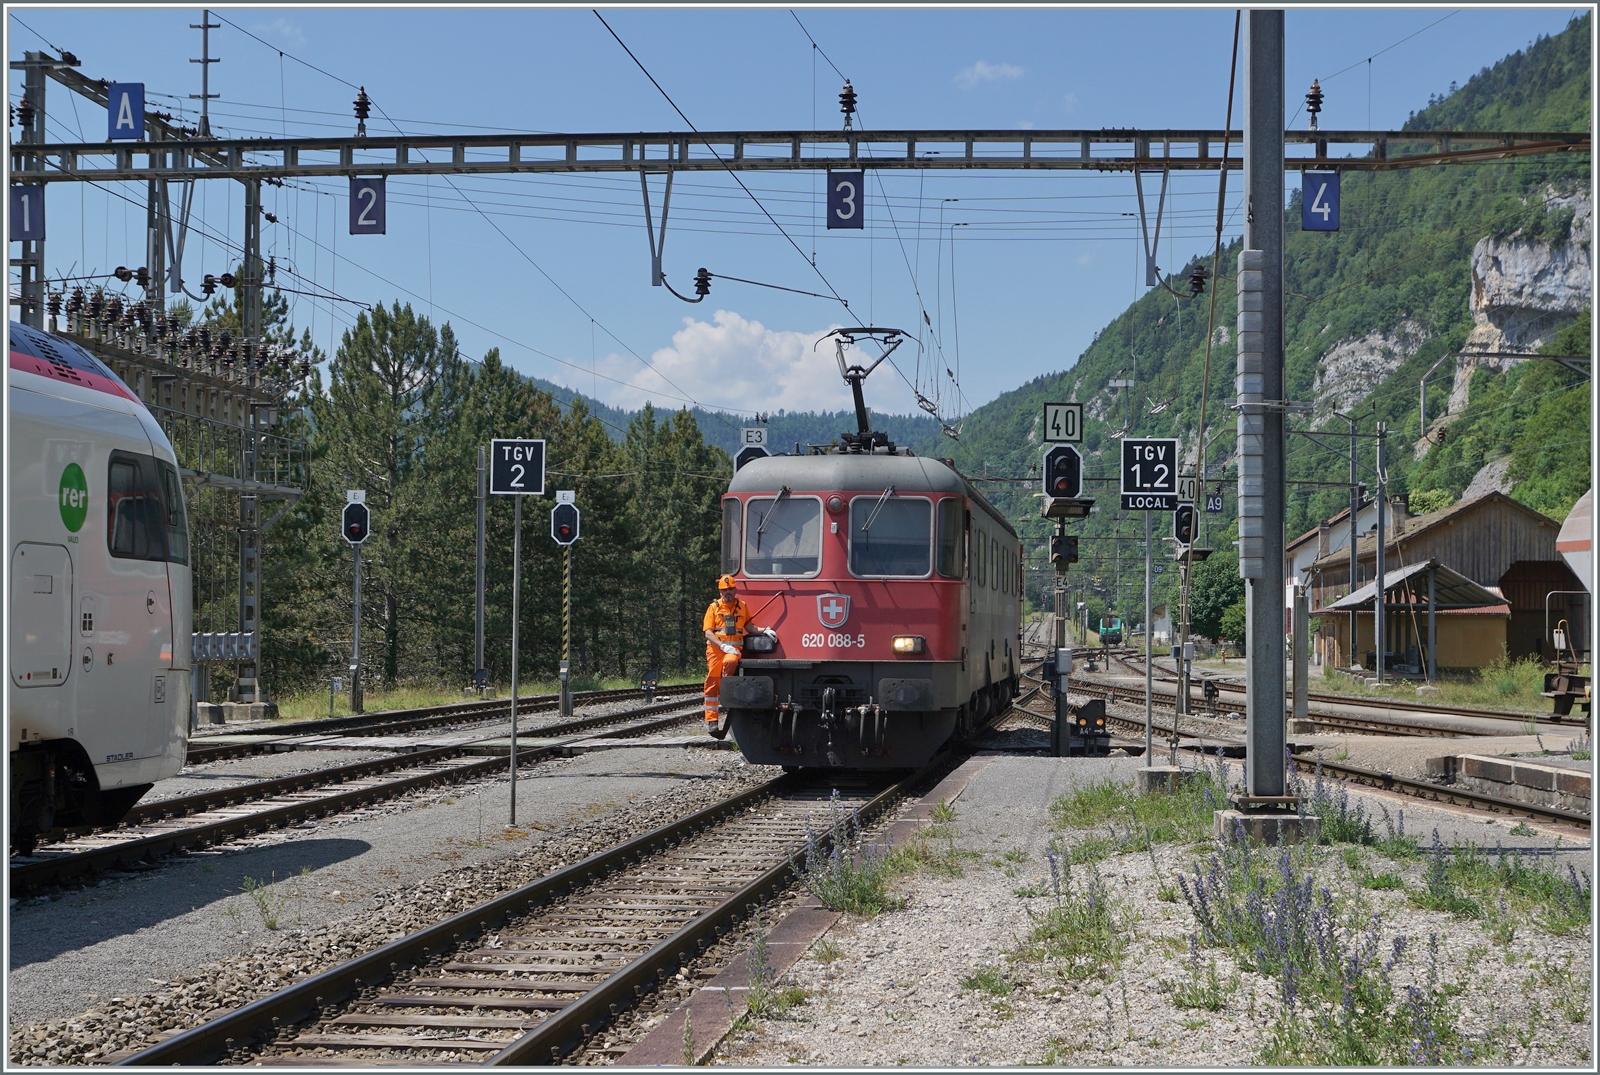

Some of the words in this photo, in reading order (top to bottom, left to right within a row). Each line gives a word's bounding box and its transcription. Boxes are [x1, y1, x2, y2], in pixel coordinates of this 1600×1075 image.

[116, 92, 134, 129] A
[358, 187, 377, 225] 2
[836, 181, 855, 220] 3
[1311, 183, 1331, 221] 4
[21, 194, 30, 232] 1
[1051, 409, 1075, 437] 40
[746, 430, 763, 443] E3
[502, 446, 534, 461] TGV
[1133, 445, 1166, 461] TGV
[510, 464, 525, 488] 2
[62, 487, 86, 509] rer
[1129, 497, 1169, 508] LOCAL
[1207, 497, 1222, 510] A9
[1056, 577, 1068, 587] E4
[801, 633, 825, 648] 620
[827, 633, 865, 648] 088-5
[106, 752, 134, 762] STADLER
